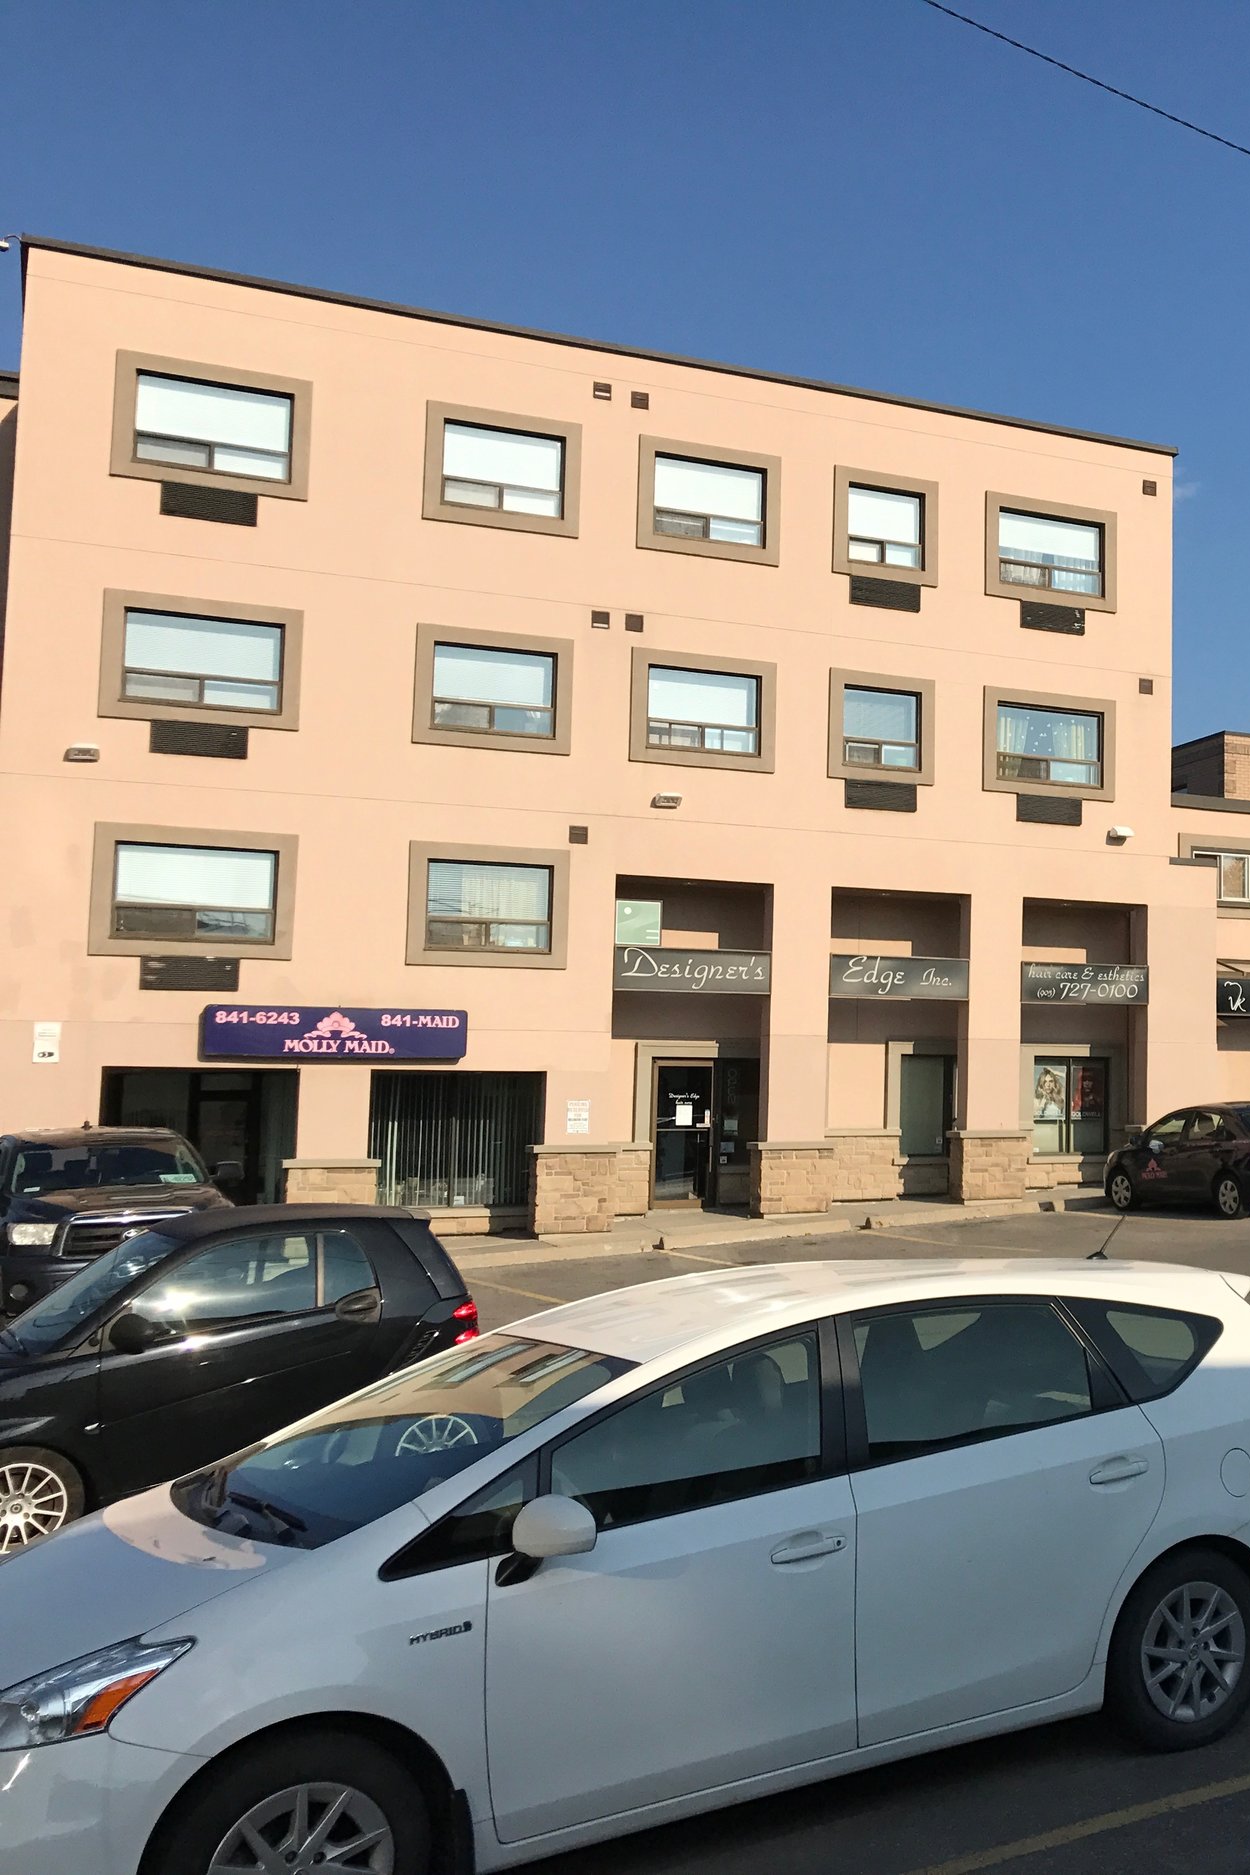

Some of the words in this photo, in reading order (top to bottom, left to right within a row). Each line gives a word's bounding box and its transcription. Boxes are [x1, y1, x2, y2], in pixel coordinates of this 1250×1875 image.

[621, 947, 766, 989] Designer's
[842, 956, 906, 994] Edge
[920, 967, 952, 986] Inc.
[1028, 963, 1052, 979] hair
[1055, 970, 1079, 980] care
[1097, 966, 1145, 982] esthetics
[1060, 982, 1139, 1000] 727-0100
[215, 1010, 300, 1025] 841-6243
[381, 1014, 461, 1028] 841-MAID
[283, 1039, 341, 1053] MOLLY
[345, 1040, 390, 1054] MAID
